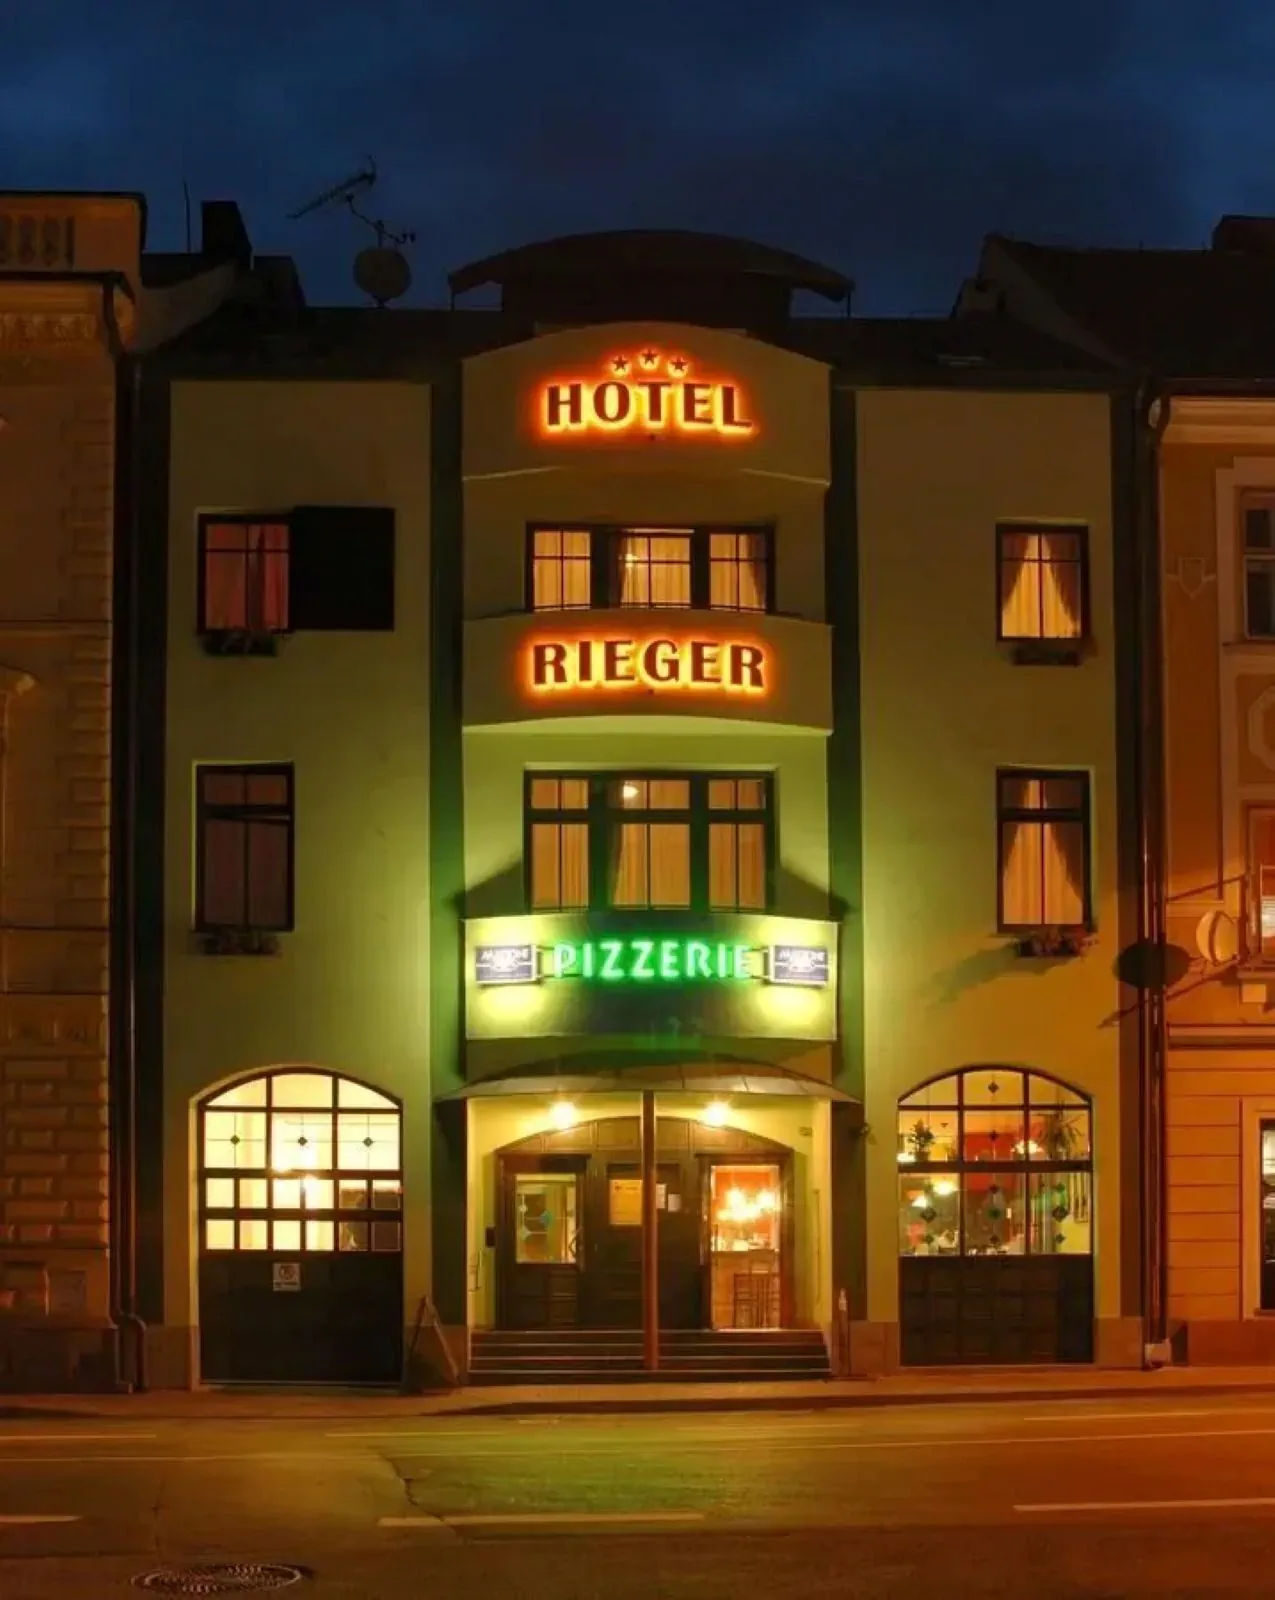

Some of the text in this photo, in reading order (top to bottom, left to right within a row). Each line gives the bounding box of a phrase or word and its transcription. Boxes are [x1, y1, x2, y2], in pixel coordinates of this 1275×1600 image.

[546, 381, 753, 428] HOTEL
[533, 639, 764, 687] RIEGER
[553, 941, 752, 978] PIZZERIE
